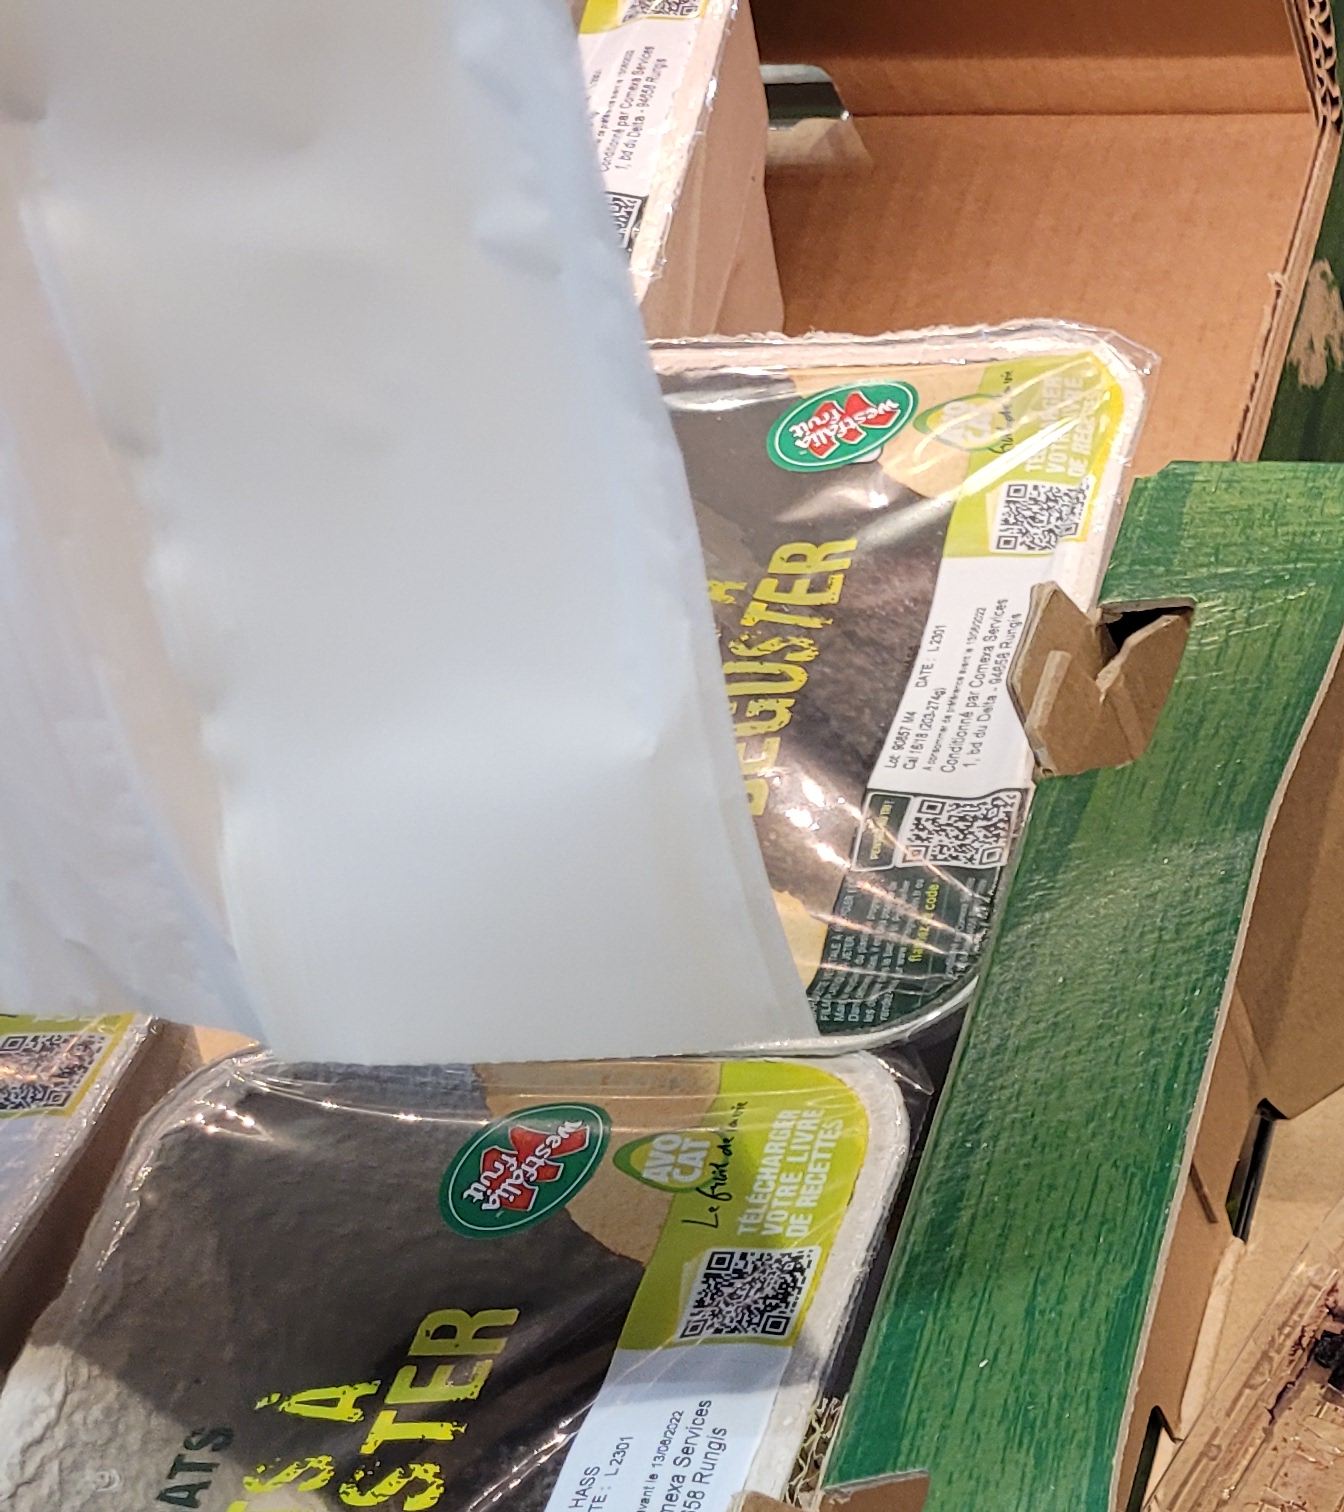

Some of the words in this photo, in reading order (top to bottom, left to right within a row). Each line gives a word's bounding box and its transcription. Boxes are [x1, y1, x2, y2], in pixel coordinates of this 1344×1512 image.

[965, 690, 979, 708] par
[925, 883, 940, 911] code
[641, 1134, 683, 1184] AVO
[673, 1137, 711, 1184] CAT
[717, 1135, 735, 1157] de
[795, 1118, 844, 1208] RECETTES
[696, 1162, 733, 1202] fruit
[737, 1109, 801, 1236] TÉLÉCHARGER
[760, 1171, 804, 1236] VOTRE
[787, 1109, 825, 1164] LIVRE
[681, 1205, 720, 1229] Le
[785, 1212, 814, 1238] DE
[673, 1399, 712, 1469] Services
[692, 1426, 727, 1487] Rungis
[568, 1465, 601, 1510] HASS
[647, 1473, 659, 1485] le
